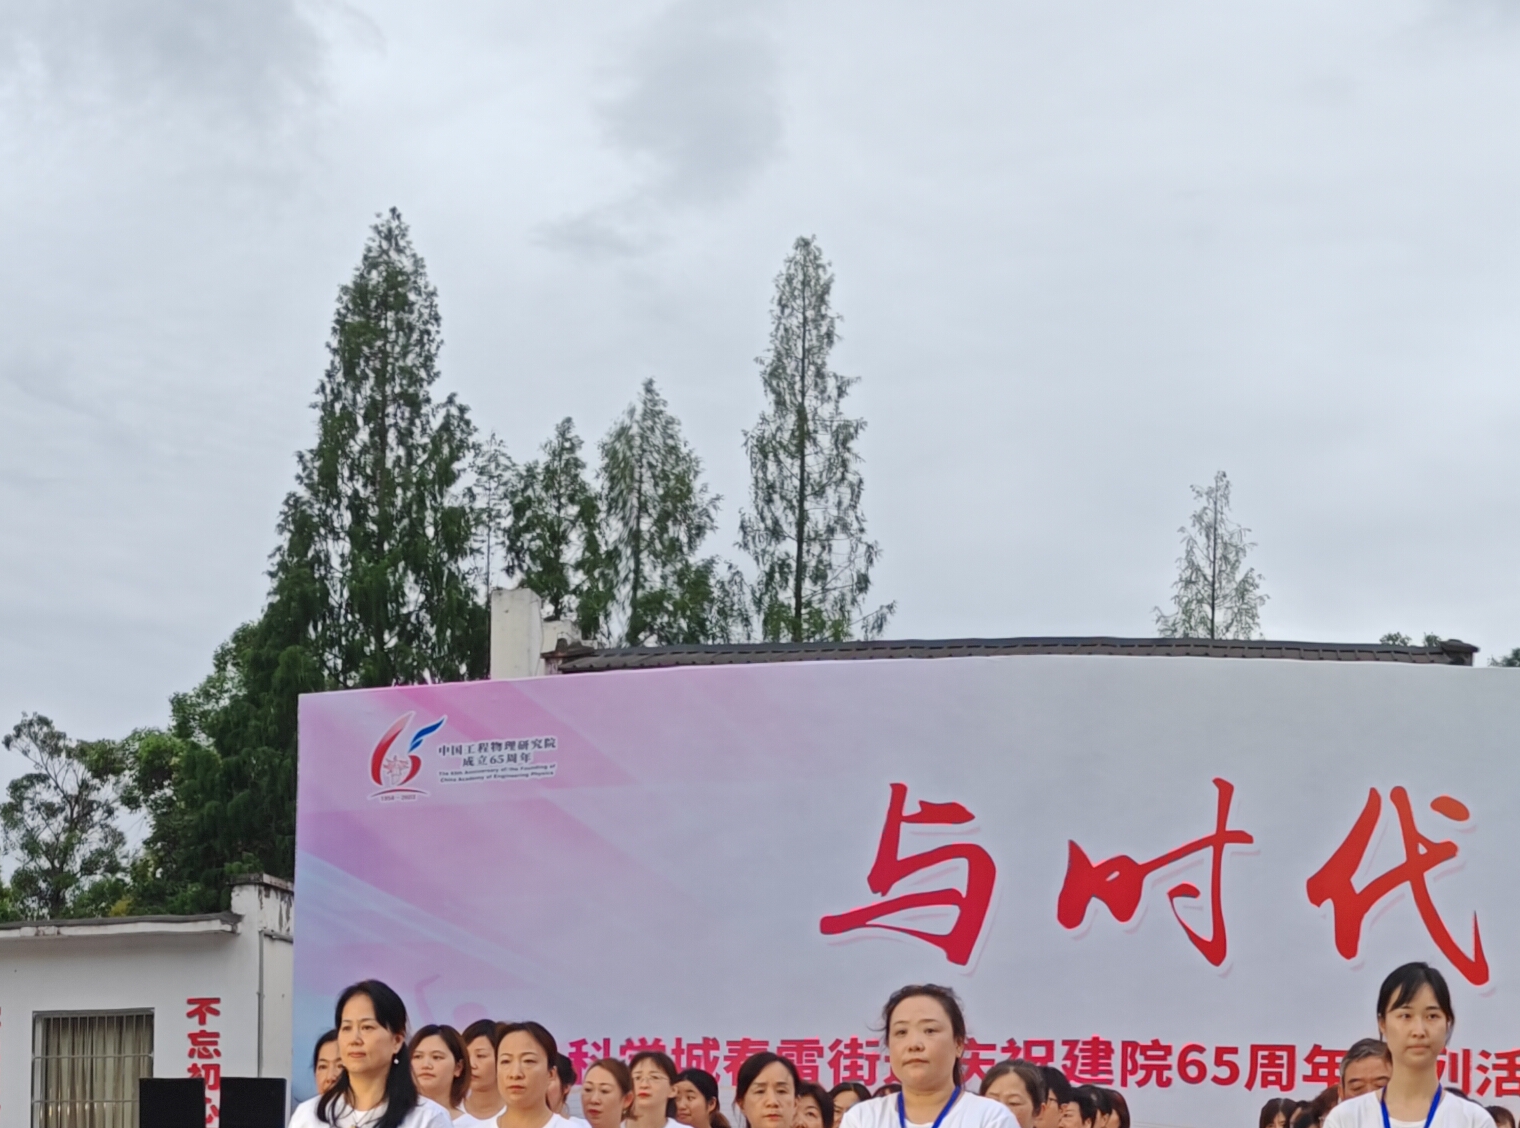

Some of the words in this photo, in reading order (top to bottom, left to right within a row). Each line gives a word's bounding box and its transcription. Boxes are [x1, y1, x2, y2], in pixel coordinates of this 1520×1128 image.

[438, 737, 557, 757] 中国工程物理研究院
[462, 752, 532, 767] 成立65周年
